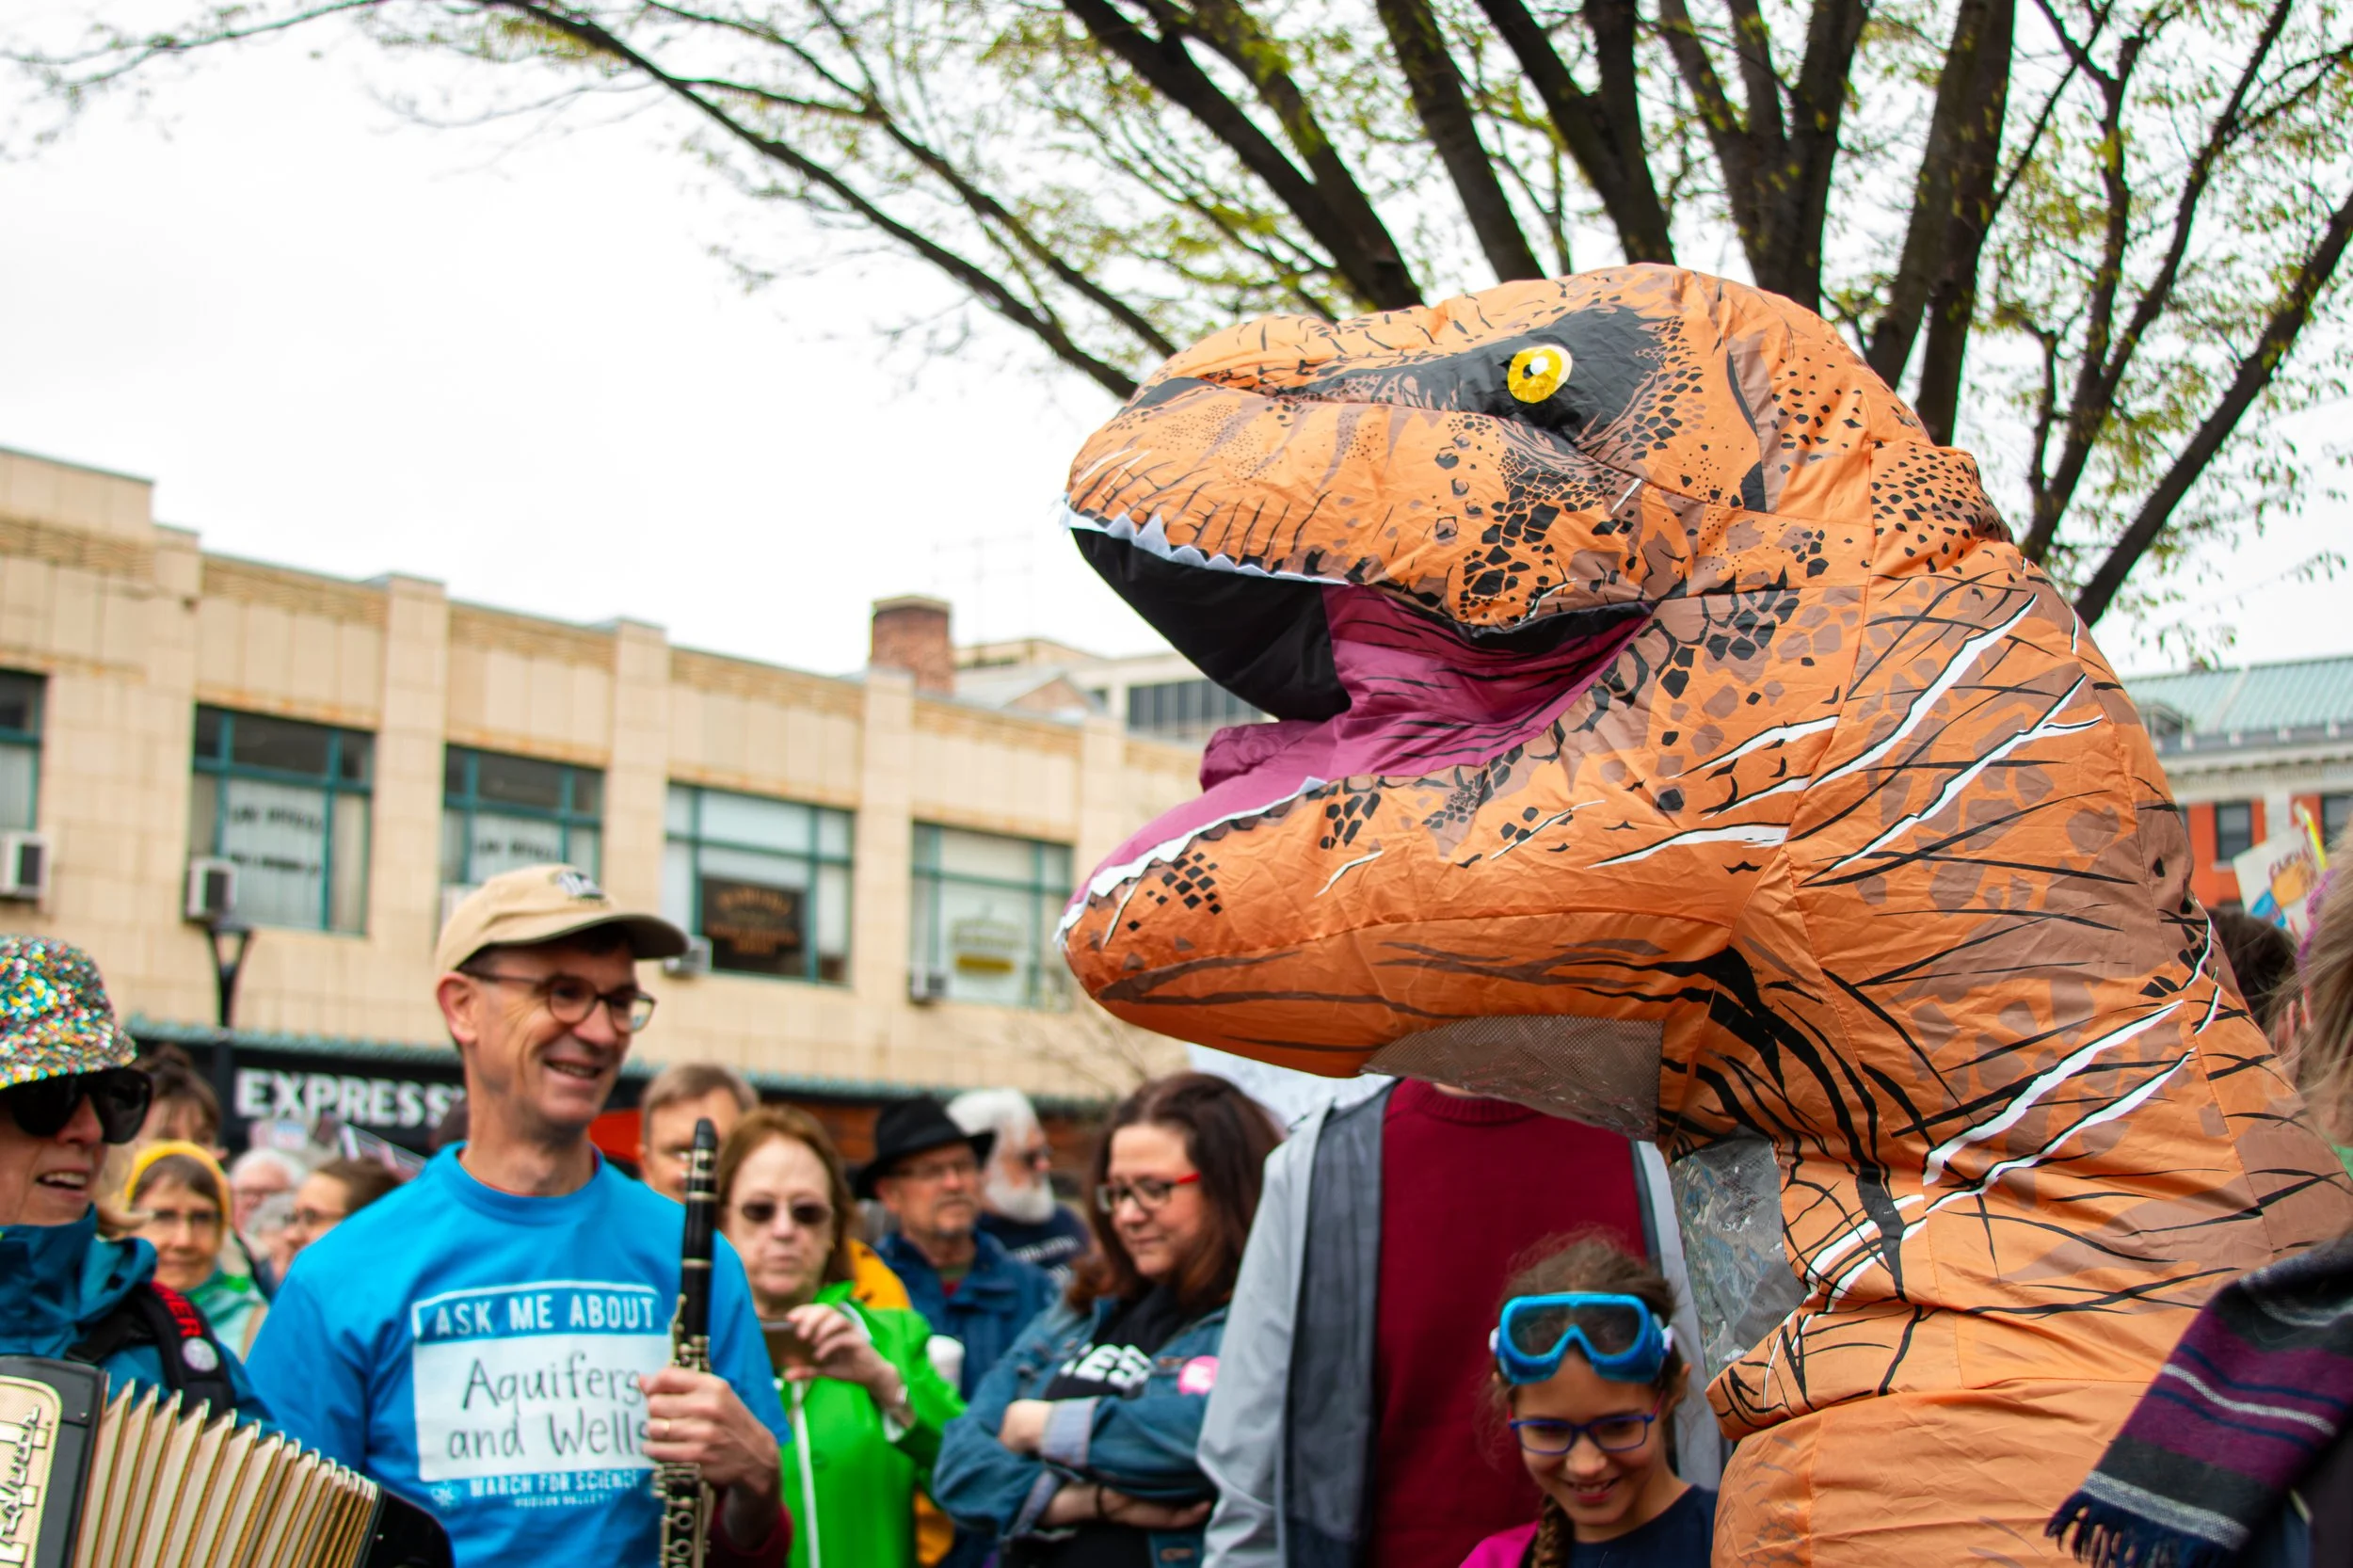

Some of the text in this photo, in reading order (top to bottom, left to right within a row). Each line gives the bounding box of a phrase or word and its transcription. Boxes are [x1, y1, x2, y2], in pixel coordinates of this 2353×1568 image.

[435, 1294, 655, 1336] ASK ME ABOUT
[461, 1350, 642, 1416] Aquifers
[448, 1416, 526, 1461] and
[470, 1473, 534, 1498] MARCH
[538, 1472, 570, 1493] FOR
